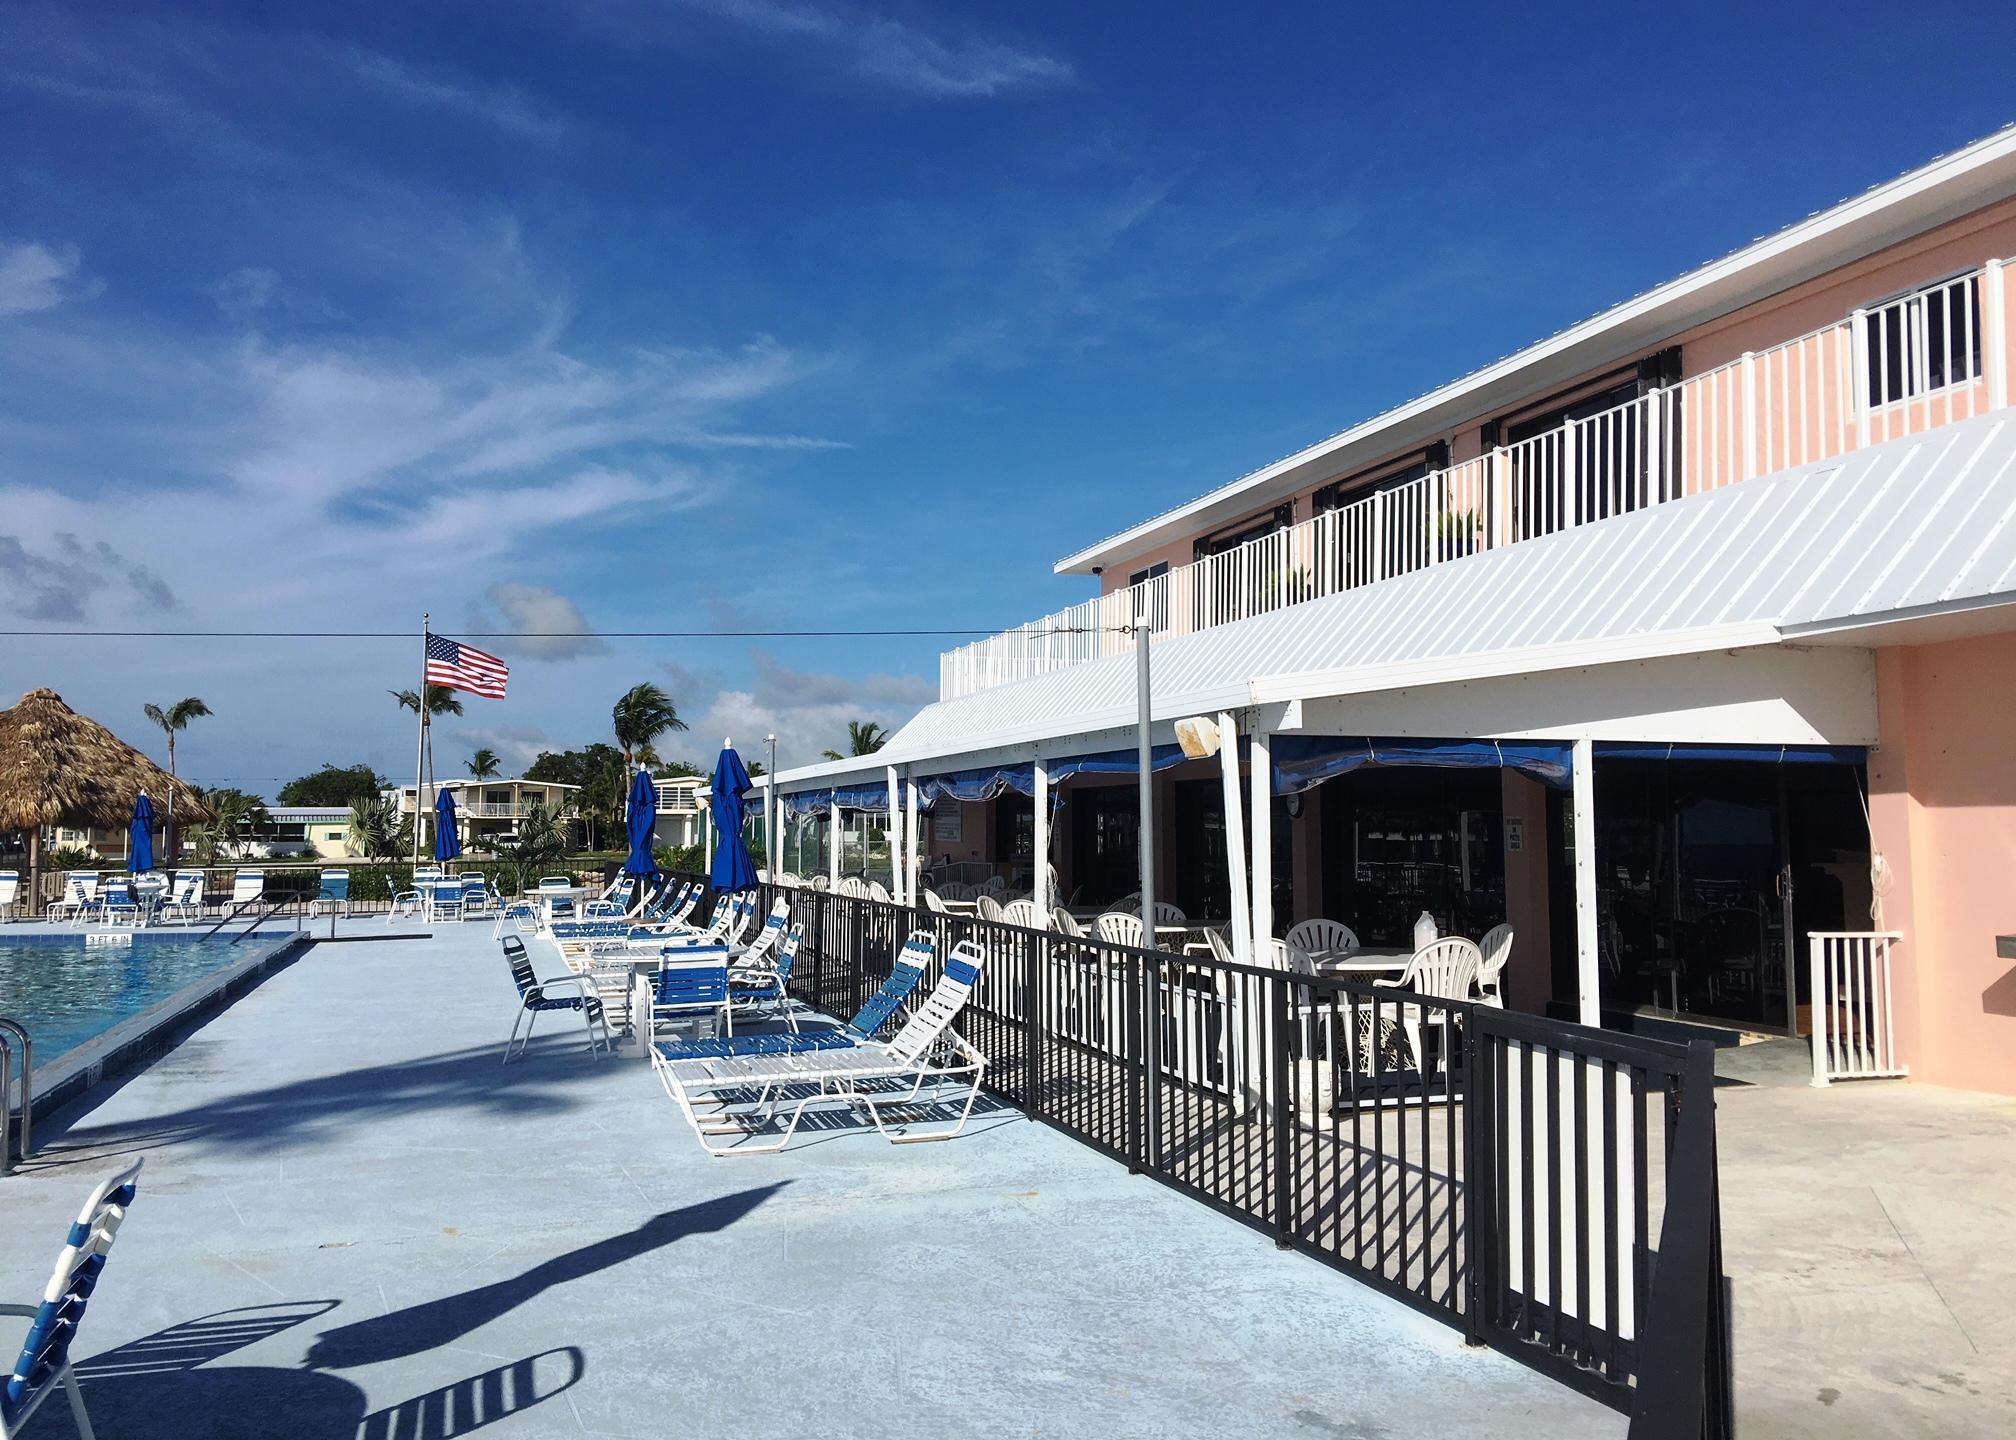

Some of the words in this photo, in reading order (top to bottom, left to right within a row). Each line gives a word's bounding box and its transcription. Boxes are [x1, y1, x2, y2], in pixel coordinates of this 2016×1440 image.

[89, 935, 95, 944] 3
[98, 935, 108, 944] FT
[112, 935, 118, 944] 6
[120, 935, 129, 944] IN
